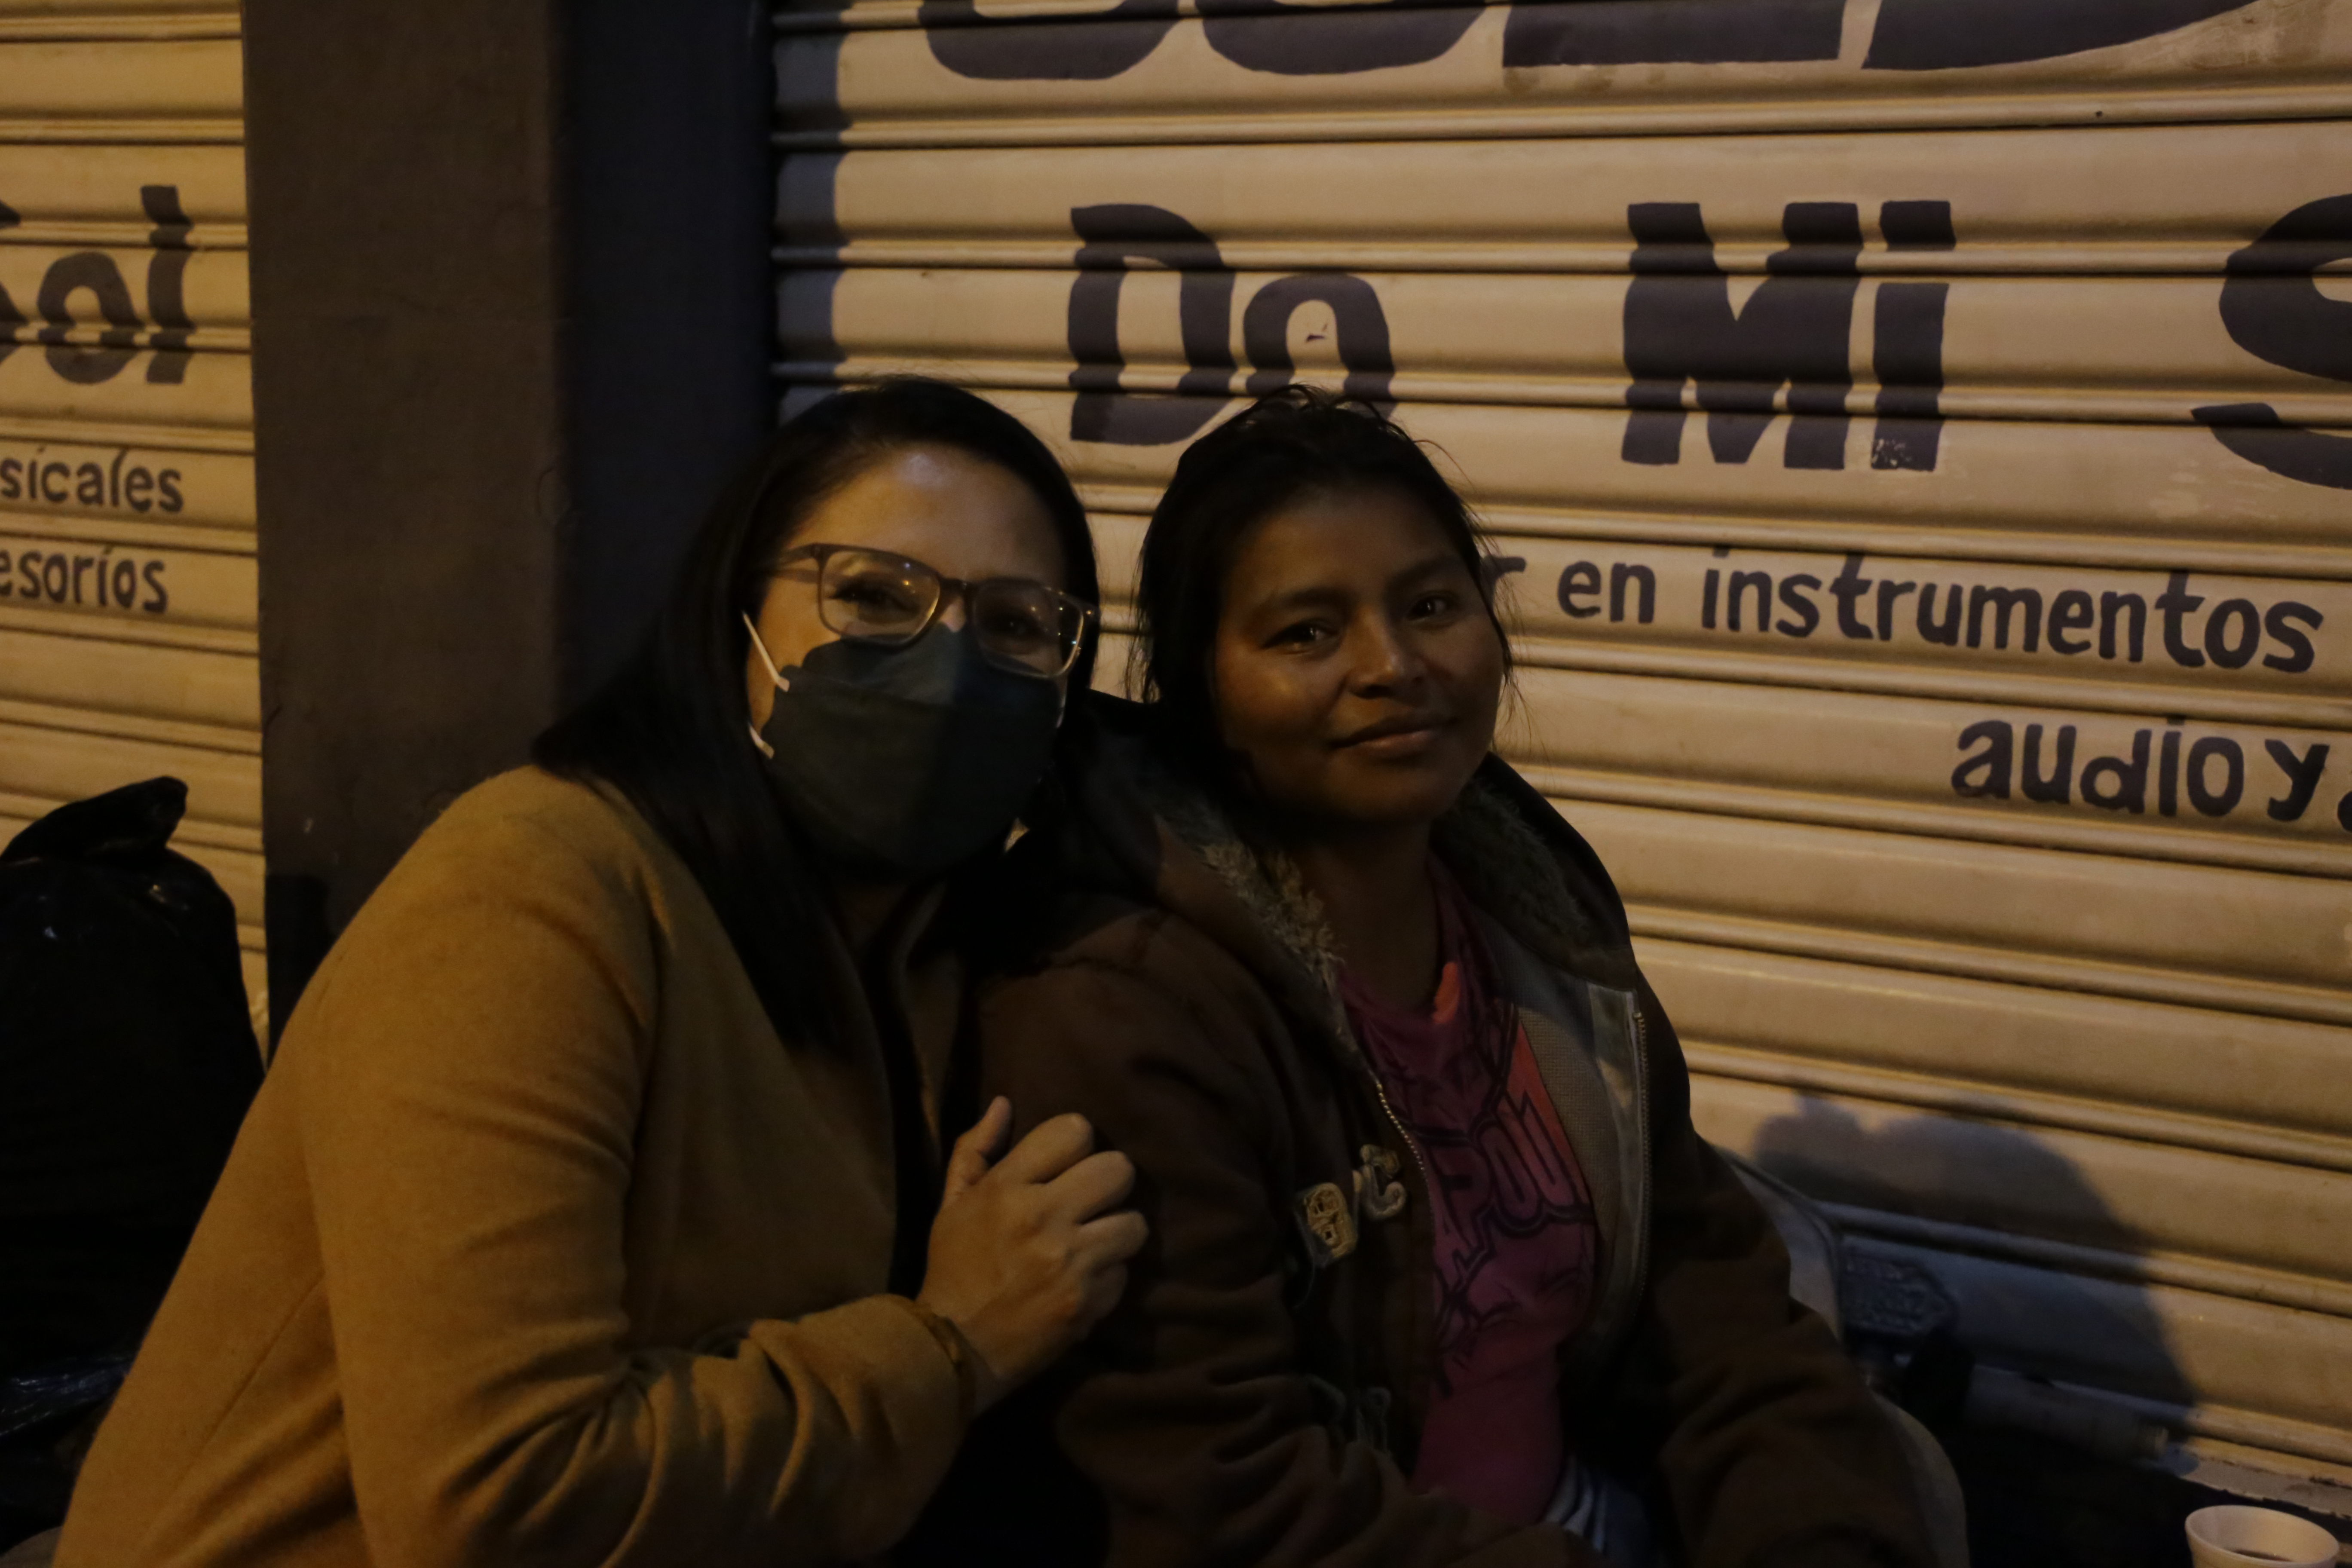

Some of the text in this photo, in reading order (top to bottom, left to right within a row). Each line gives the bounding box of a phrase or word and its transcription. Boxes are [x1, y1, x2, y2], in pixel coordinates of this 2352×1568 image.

[0, 186, 194, 384] ol
[1621, 201, 1957, 472] Mi
[1557, 561, 1656, 624] en
[1702, 545, 2324, 673] instrumentos
[1951, 715, 2245, 817] audio
[2265, 739, 2330, 821] y
